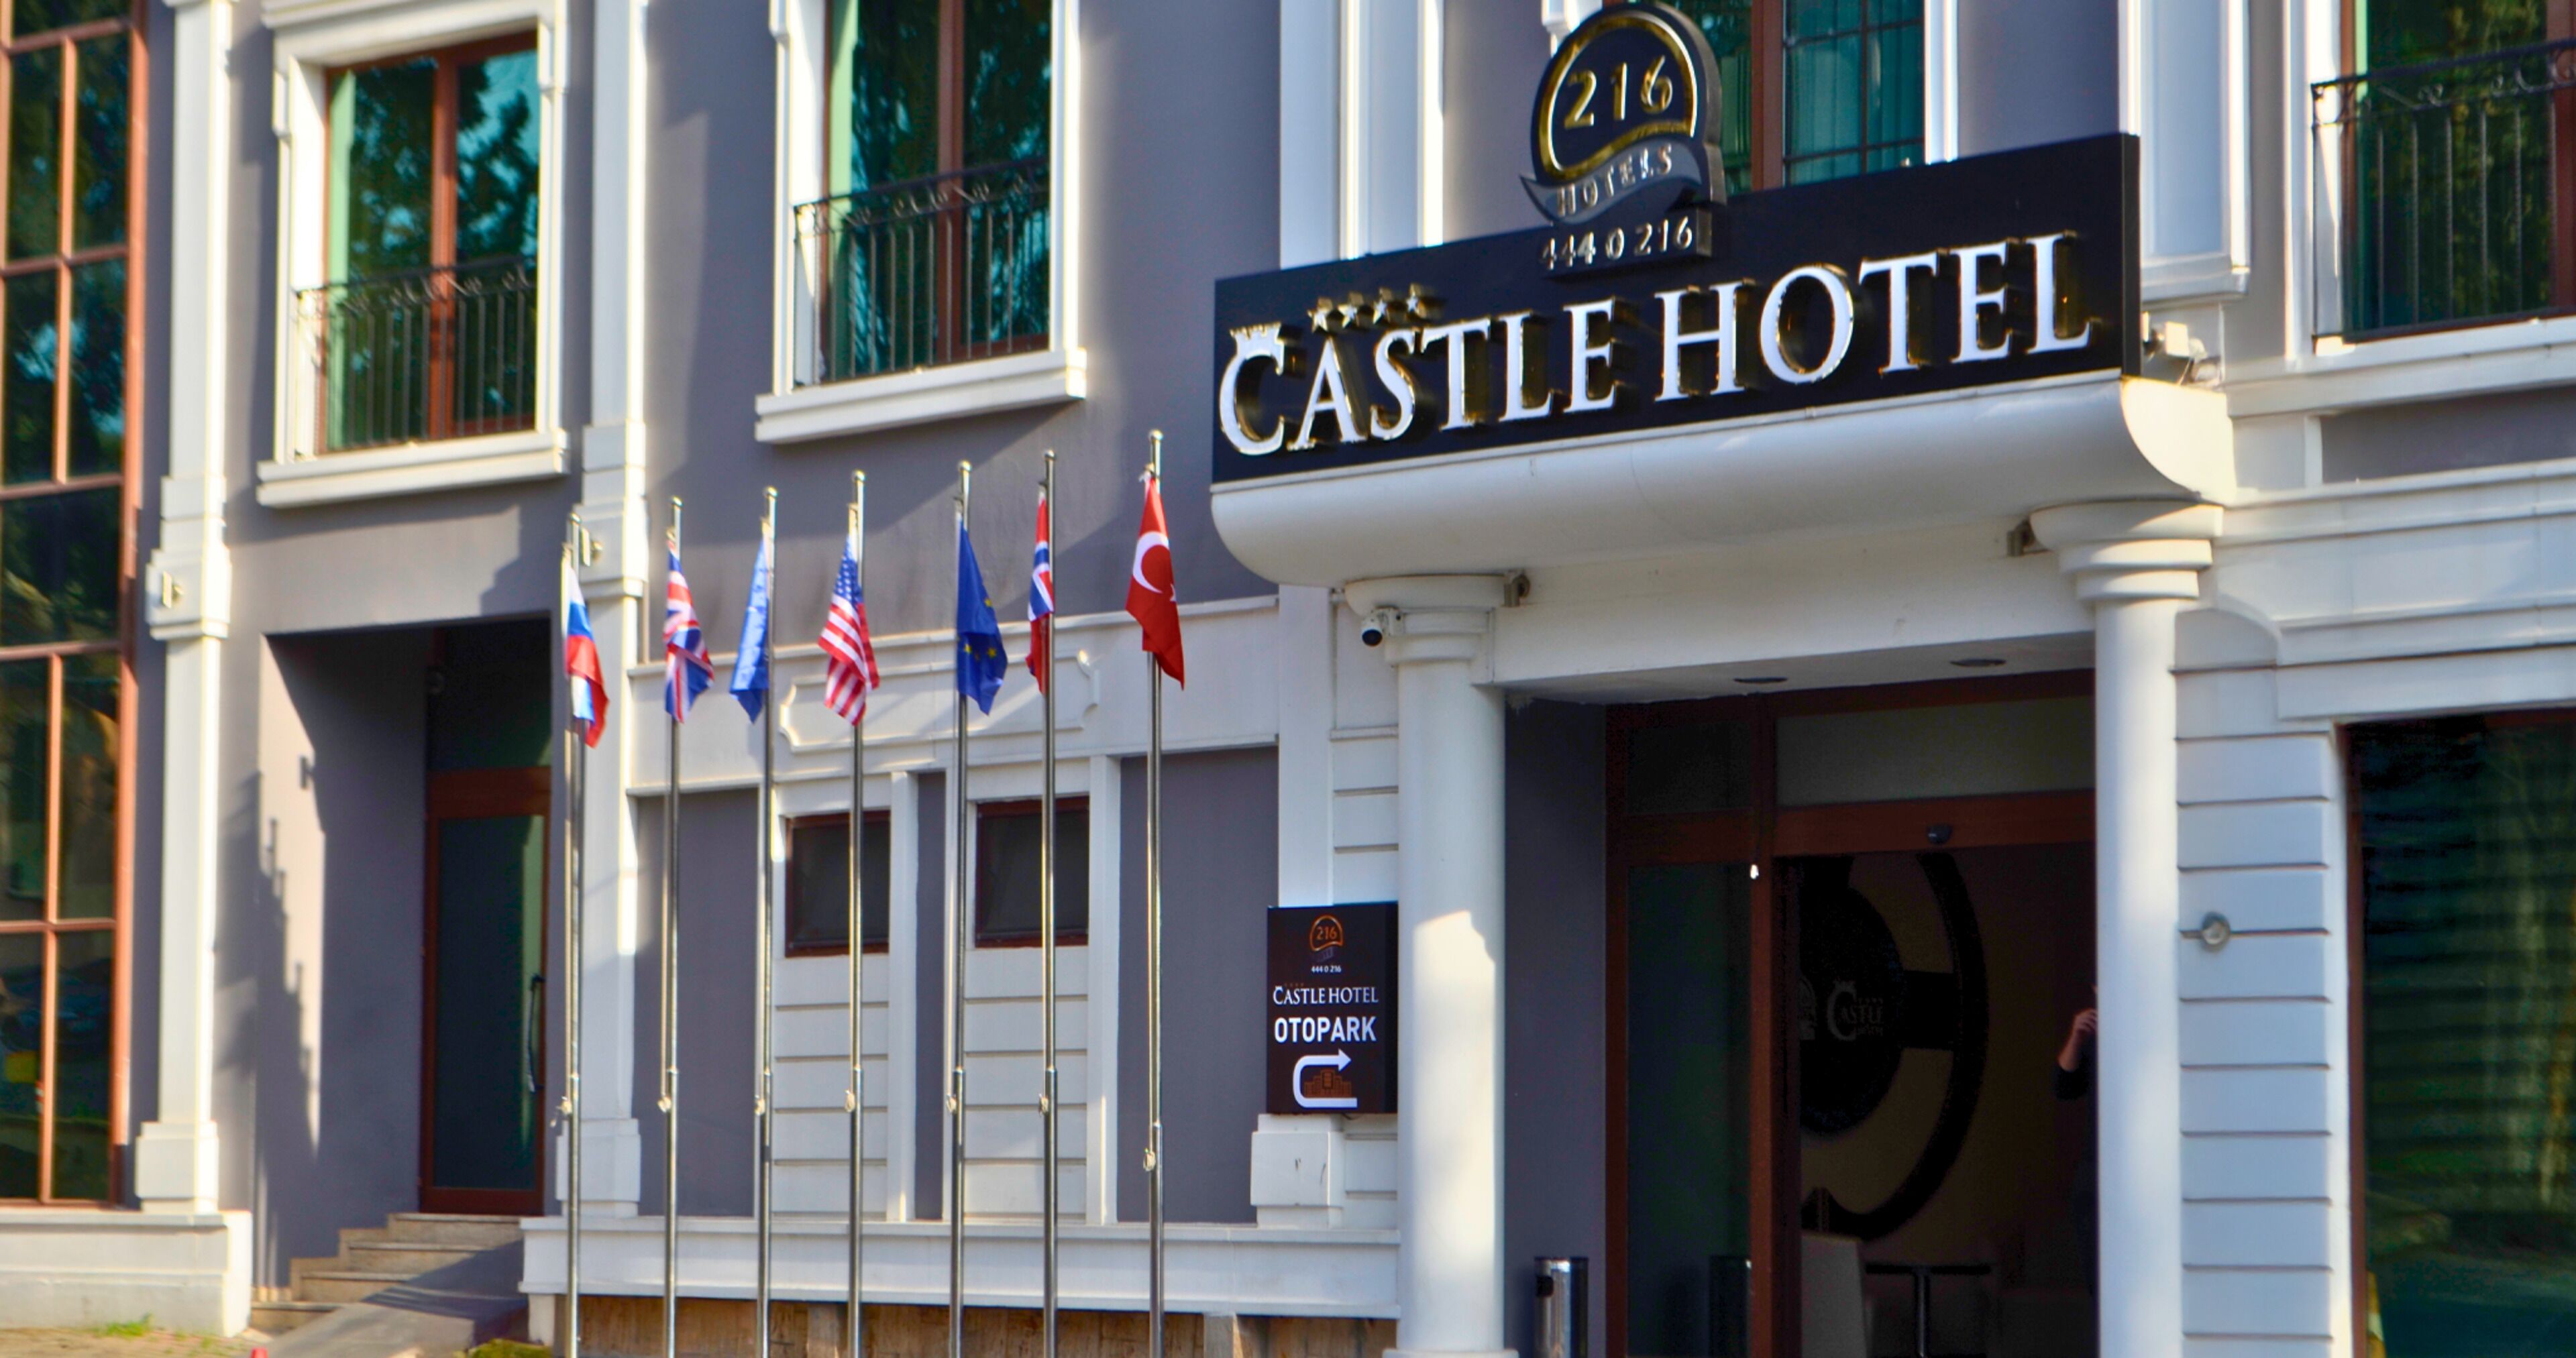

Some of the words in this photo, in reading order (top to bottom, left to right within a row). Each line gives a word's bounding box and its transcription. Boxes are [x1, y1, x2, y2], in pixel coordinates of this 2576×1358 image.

[1563, 54, 1673, 128] 216
[1555, 145, 1674, 216] HOTELS
[1542, 231, 1596, 271] 444
[1605, 228, 1625, 258] 0
[1634, 216, 1694, 254] 216
[1219, 296, 1617, 456] CASTLE
[1655, 232, 2092, 401] HOTEL
[1316, 926, 1337, 940] 216
[1273, 986, 1326, 1005] CASTLE
[1329, 986, 1379, 1003] HOTEL
[1274, 1016, 1377, 1043] OTOPARK
